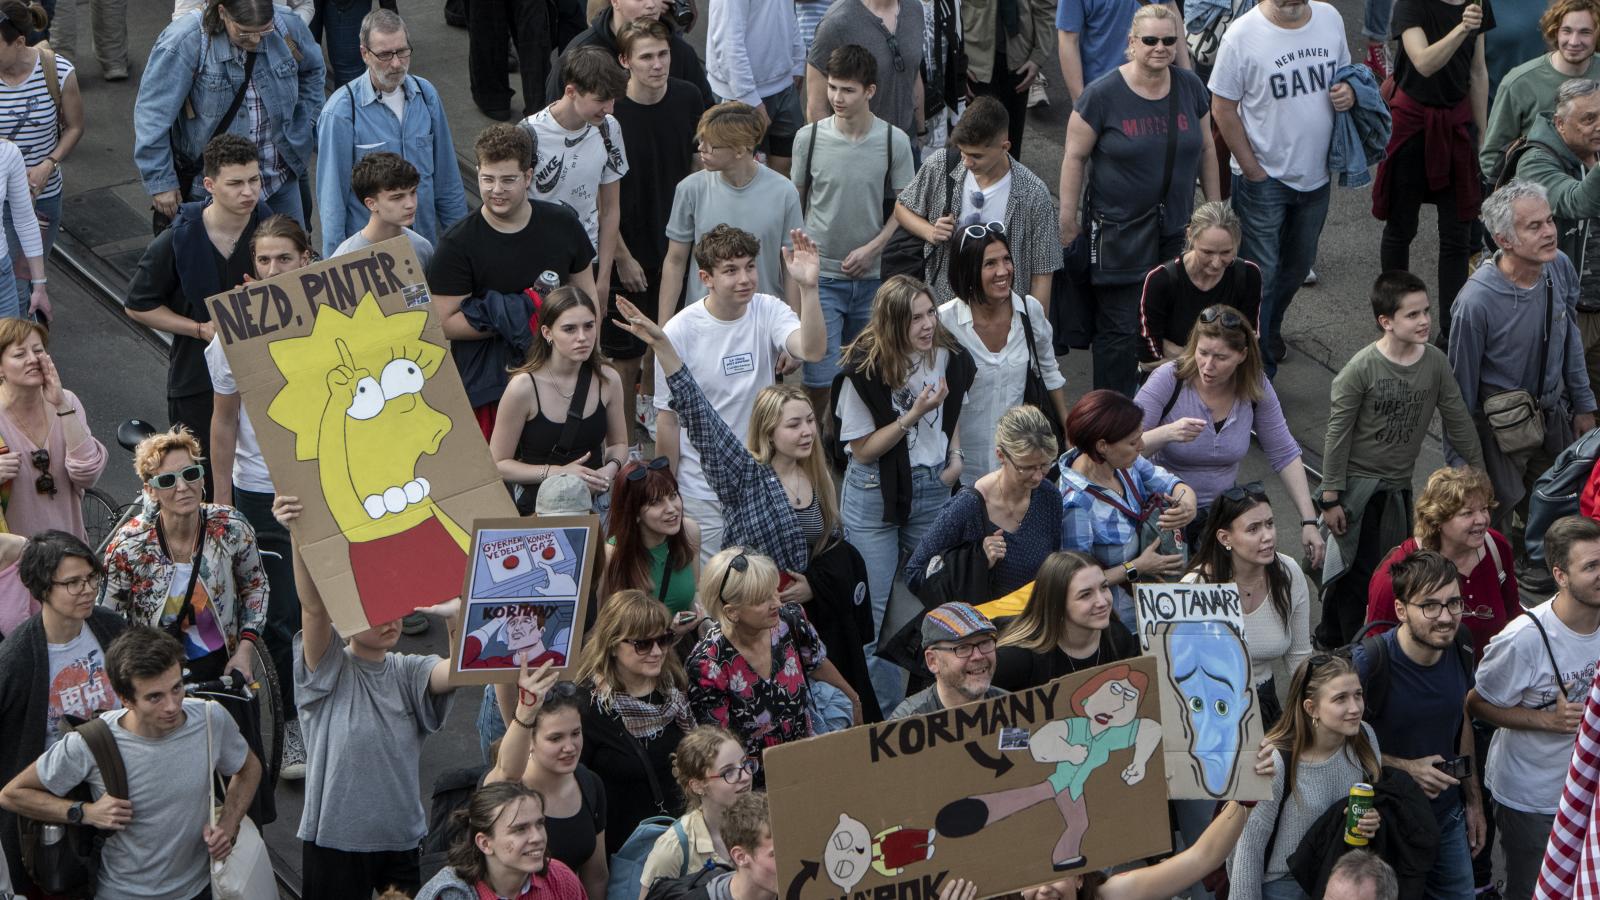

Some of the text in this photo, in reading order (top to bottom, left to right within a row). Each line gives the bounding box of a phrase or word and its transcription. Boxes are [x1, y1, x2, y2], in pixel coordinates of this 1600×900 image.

[1274, 47, 1329, 68] NEW HAVEN
[1269, 60, 1337, 100] GANT
[535, 155, 561, 182] NIKE
[869, 682, 1061, 763] KORMÁNY
